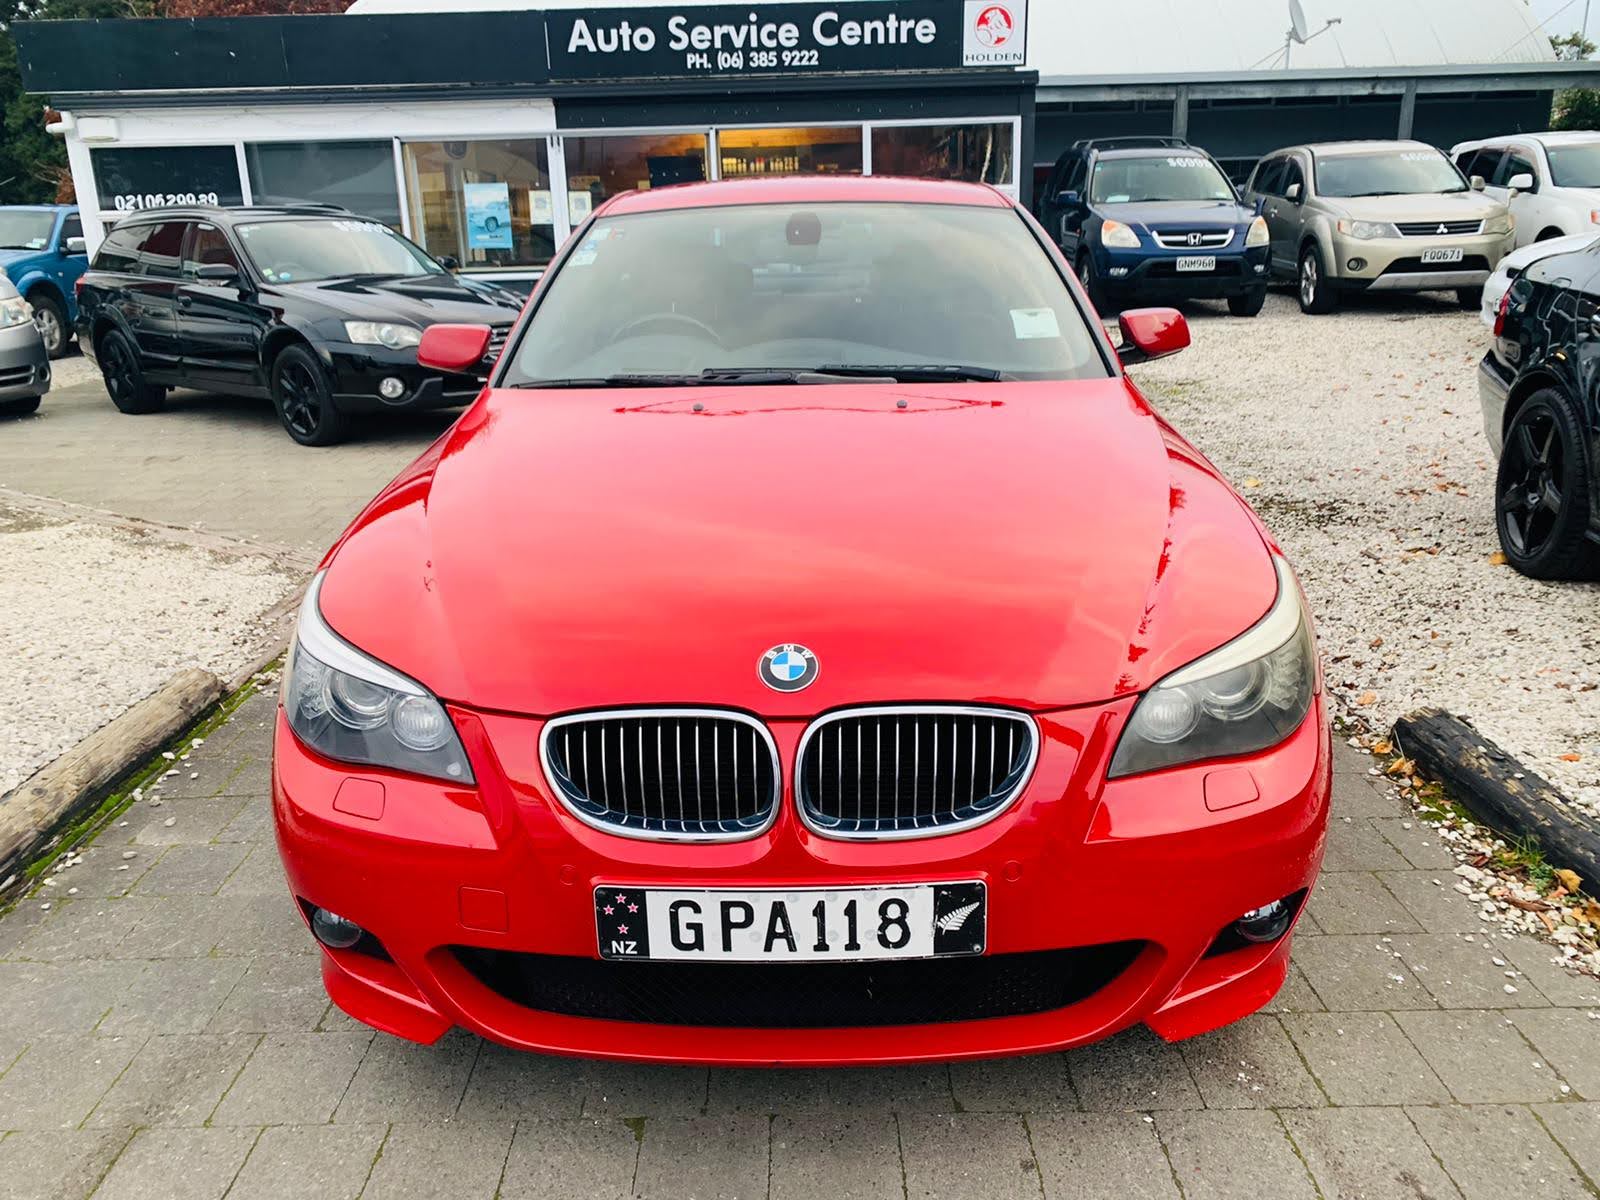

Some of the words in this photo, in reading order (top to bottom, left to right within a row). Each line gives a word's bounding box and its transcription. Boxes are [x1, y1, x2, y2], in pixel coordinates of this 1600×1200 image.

[567, 19, 656, 53] Auto
[668, 12, 799, 50] Service
[812, 11, 936, 46] Centre
[686, 53, 712, 69] PH.
[717, 51, 744, 70] (06)
[749, 52, 778, 68] 385
[781, 50, 819, 67] 9222
[965, 53, 1022, 62] HOLDEN
[765, 644, 814, 659] BMW
[669, 899, 911, 952] GPA118
[611, 940, 638, 955] NZ
